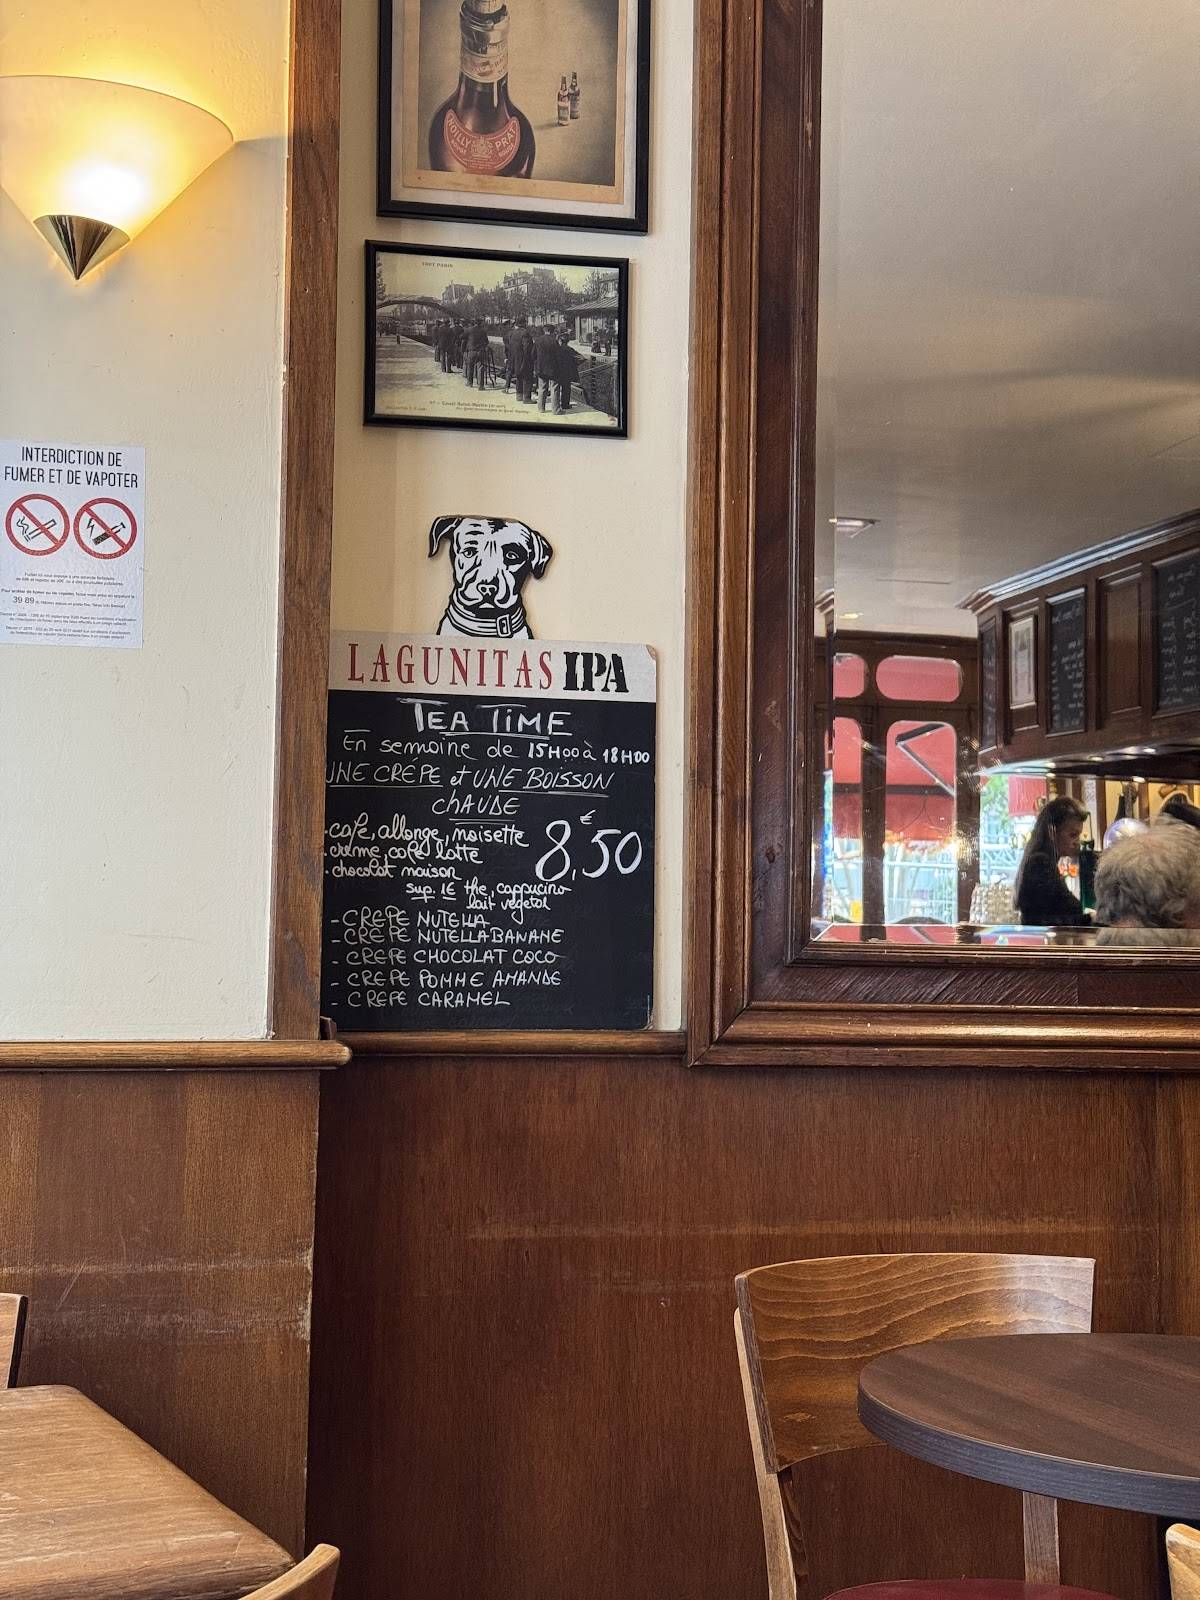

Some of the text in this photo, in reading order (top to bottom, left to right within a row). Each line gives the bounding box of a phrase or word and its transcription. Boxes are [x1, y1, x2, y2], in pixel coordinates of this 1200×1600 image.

[495, 127, 516, 151] PRAT
[21, 446, 123, 467] INTERDICTION DE
[4, 466, 138, 488] FUMER ET DE VAPOTER
[347, 642, 630, 693] LAGUNITAS IPA
[396, 698, 469, 733] TEA
[343, 729, 371, 752] En
[487, 739, 520, 758] de
[528, 742, 579, 760] 15H00
[582, 739, 597, 761] à
[602, 746, 650, 765] 18H00
[450, 765, 473, 786] et
[473, 765, 522, 789] UNE
[522, 766, 615, 789] BOISSON
[451, 823, 530, 847] noisette
[535, 819, 643, 882] 8,50
[332, 858, 462, 881] chocolat maison
[466, 893, 497, 911] lait
[342, 905, 410, 928] CREPE
[417, 909, 490, 928] NUTELLA
[344, 926, 411, 945] CREPE
[417, 928, 490, 944] NUTELLA
[490, 927, 565, 944] BANANE
[346, 947, 407, 965] CREPE
[413, 948, 508, 965] CHOCOLAT
[512, 949, 566, 965] COCO
[347, 969, 411, 987] CREPE
[419, 969, 484, 989] POMME
[492, 970, 562, 988] AMANDE
[348, 989, 408, 1008] CREPE
[417, 990, 511, 1009] CARAMEL
